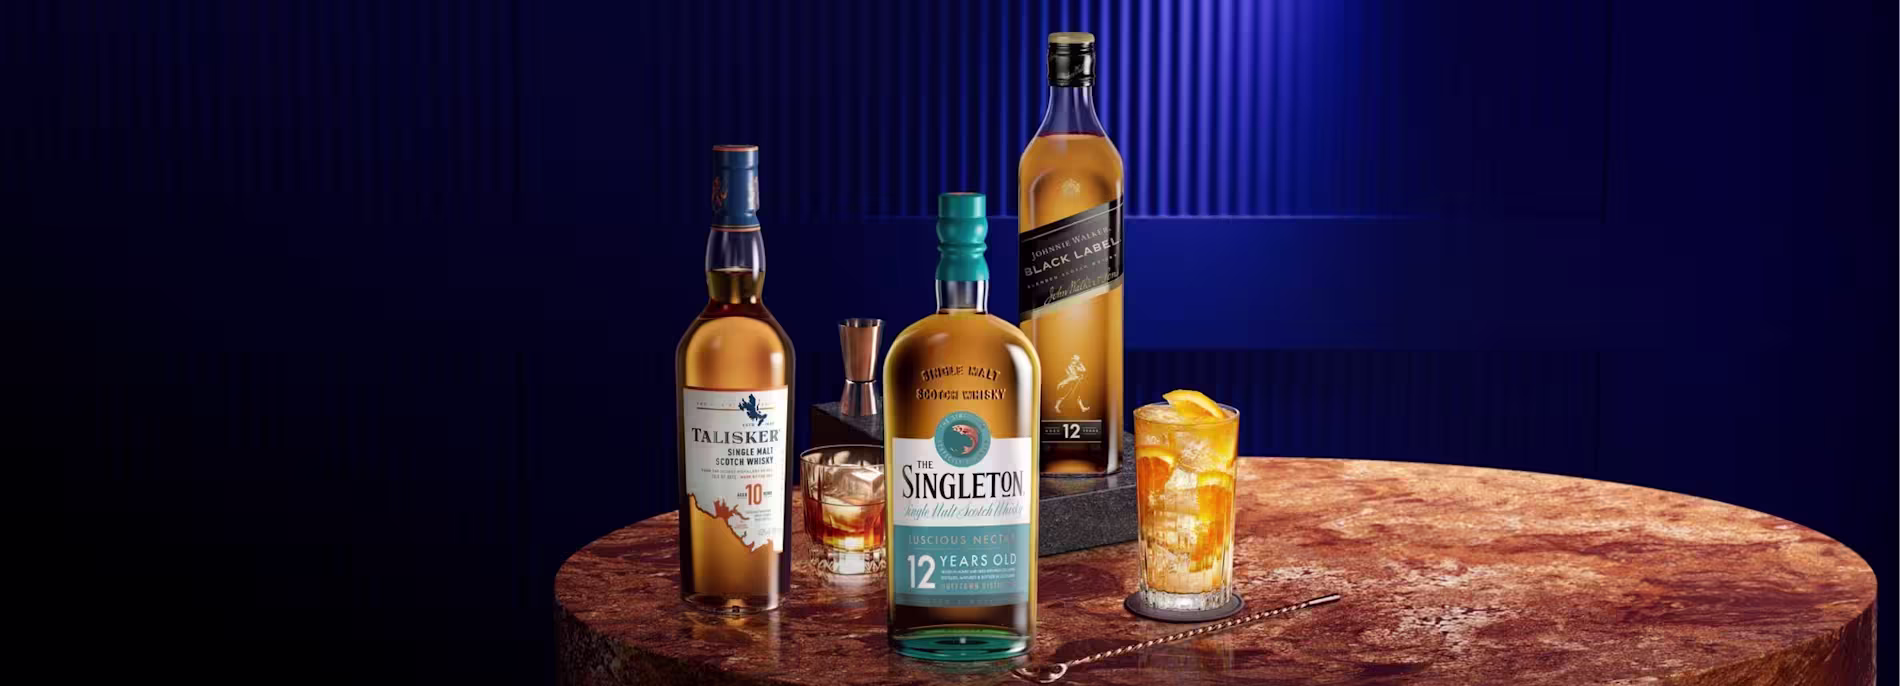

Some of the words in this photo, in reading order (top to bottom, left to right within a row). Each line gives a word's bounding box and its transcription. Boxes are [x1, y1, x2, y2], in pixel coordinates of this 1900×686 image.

[1032, 241, 1071, 261] JOHNNIE
[1072, 227, 1109, 244] WALKER
[1024, 254, 1071, 277] BLACK
[1074, 237, 1120, 259] LABEL
[921, 366, 963, 381] SINGLE
[968, 366, 1001, 381] MALT
[916, 388, 959, 400] SCOTCH
[962, 389, 1006, 400] WHISKY
[691, 427, 779, 444] TALISKER
[1062, 423, 1080, 439] 12
[727, 448, 754, 456] SINGLE
[756, 447, 774, 456] MALT
[715, 458, 744, 466] SCOTCH
[746, 456, 774, 466] WHISKY
[917, 460, 934, 469] THE
[902, 464, 1024, 500] SINGLETON
[745, 483, 762, 505] 10
[908, 535, 967, 545] LUSCIOUS
[940, 554, 988, 567] YEARS
[992, 553, 1017, 566] OLD
[907, 554, 936, 589] 12
